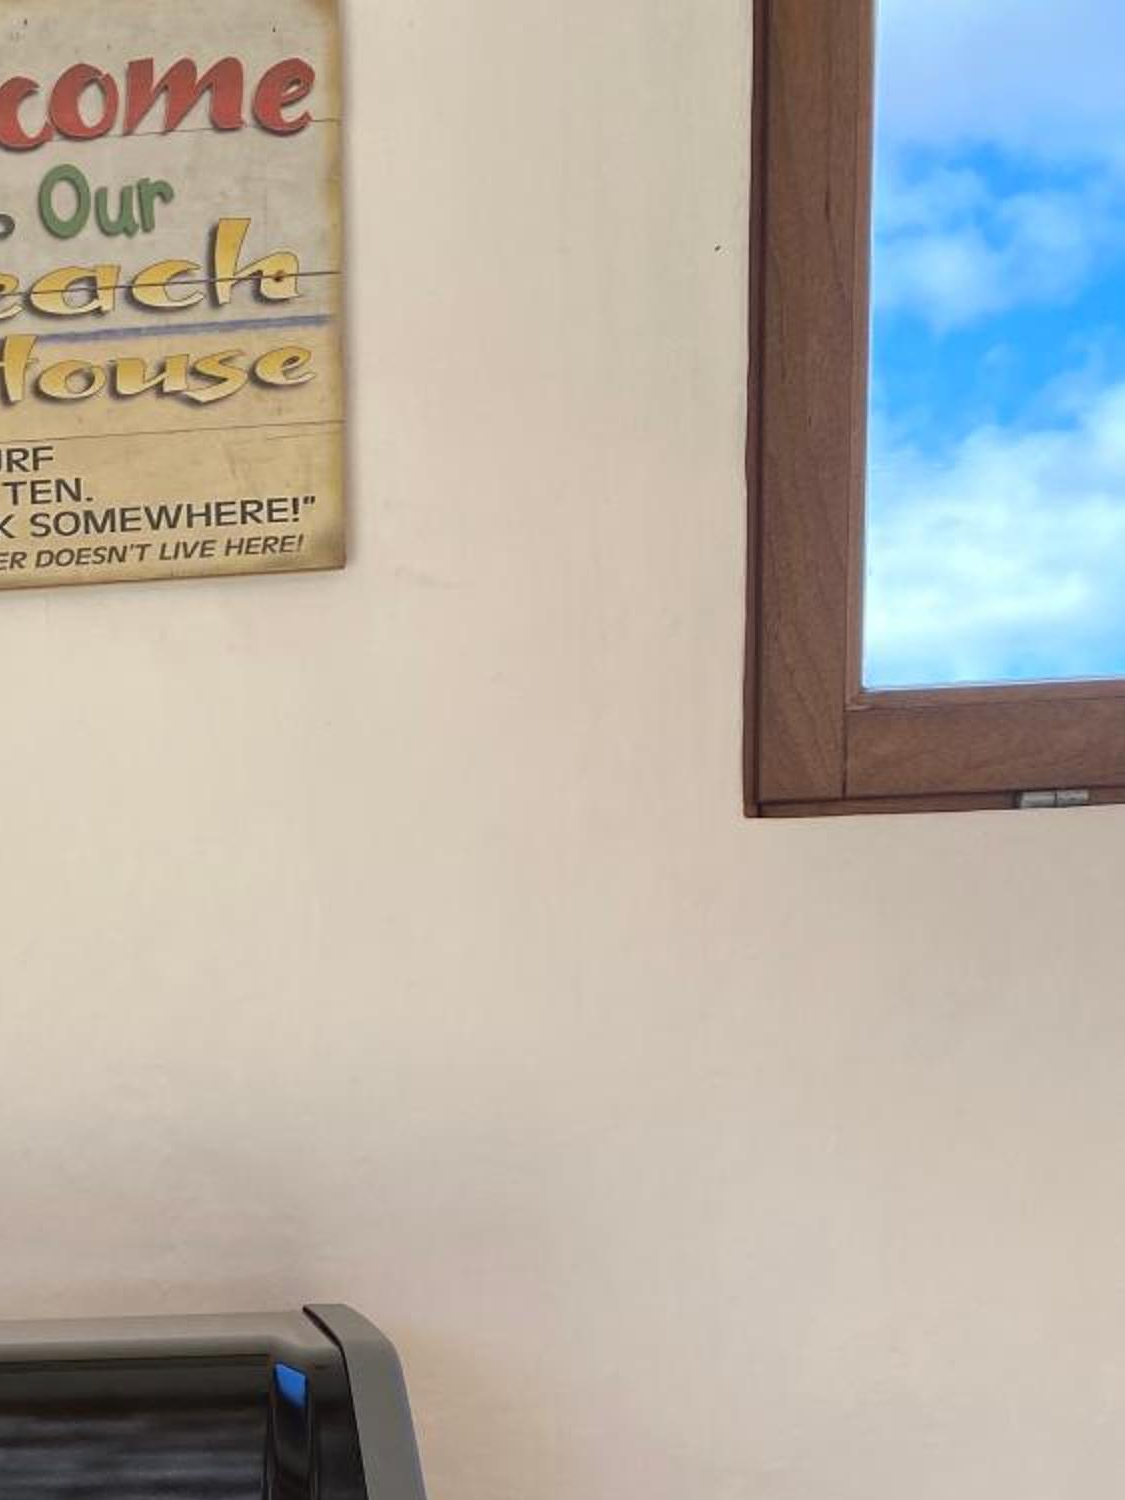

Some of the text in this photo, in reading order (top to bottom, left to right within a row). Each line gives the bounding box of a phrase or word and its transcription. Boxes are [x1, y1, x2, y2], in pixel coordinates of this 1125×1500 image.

[38, 164, 175, 239] Our
[2, 478, 93, 506] TEN.
[35, 543, 151, 568] DOESN'T
[159, 540, 216, 561] LIVE
[224, 534, 304, 556] HERE!
